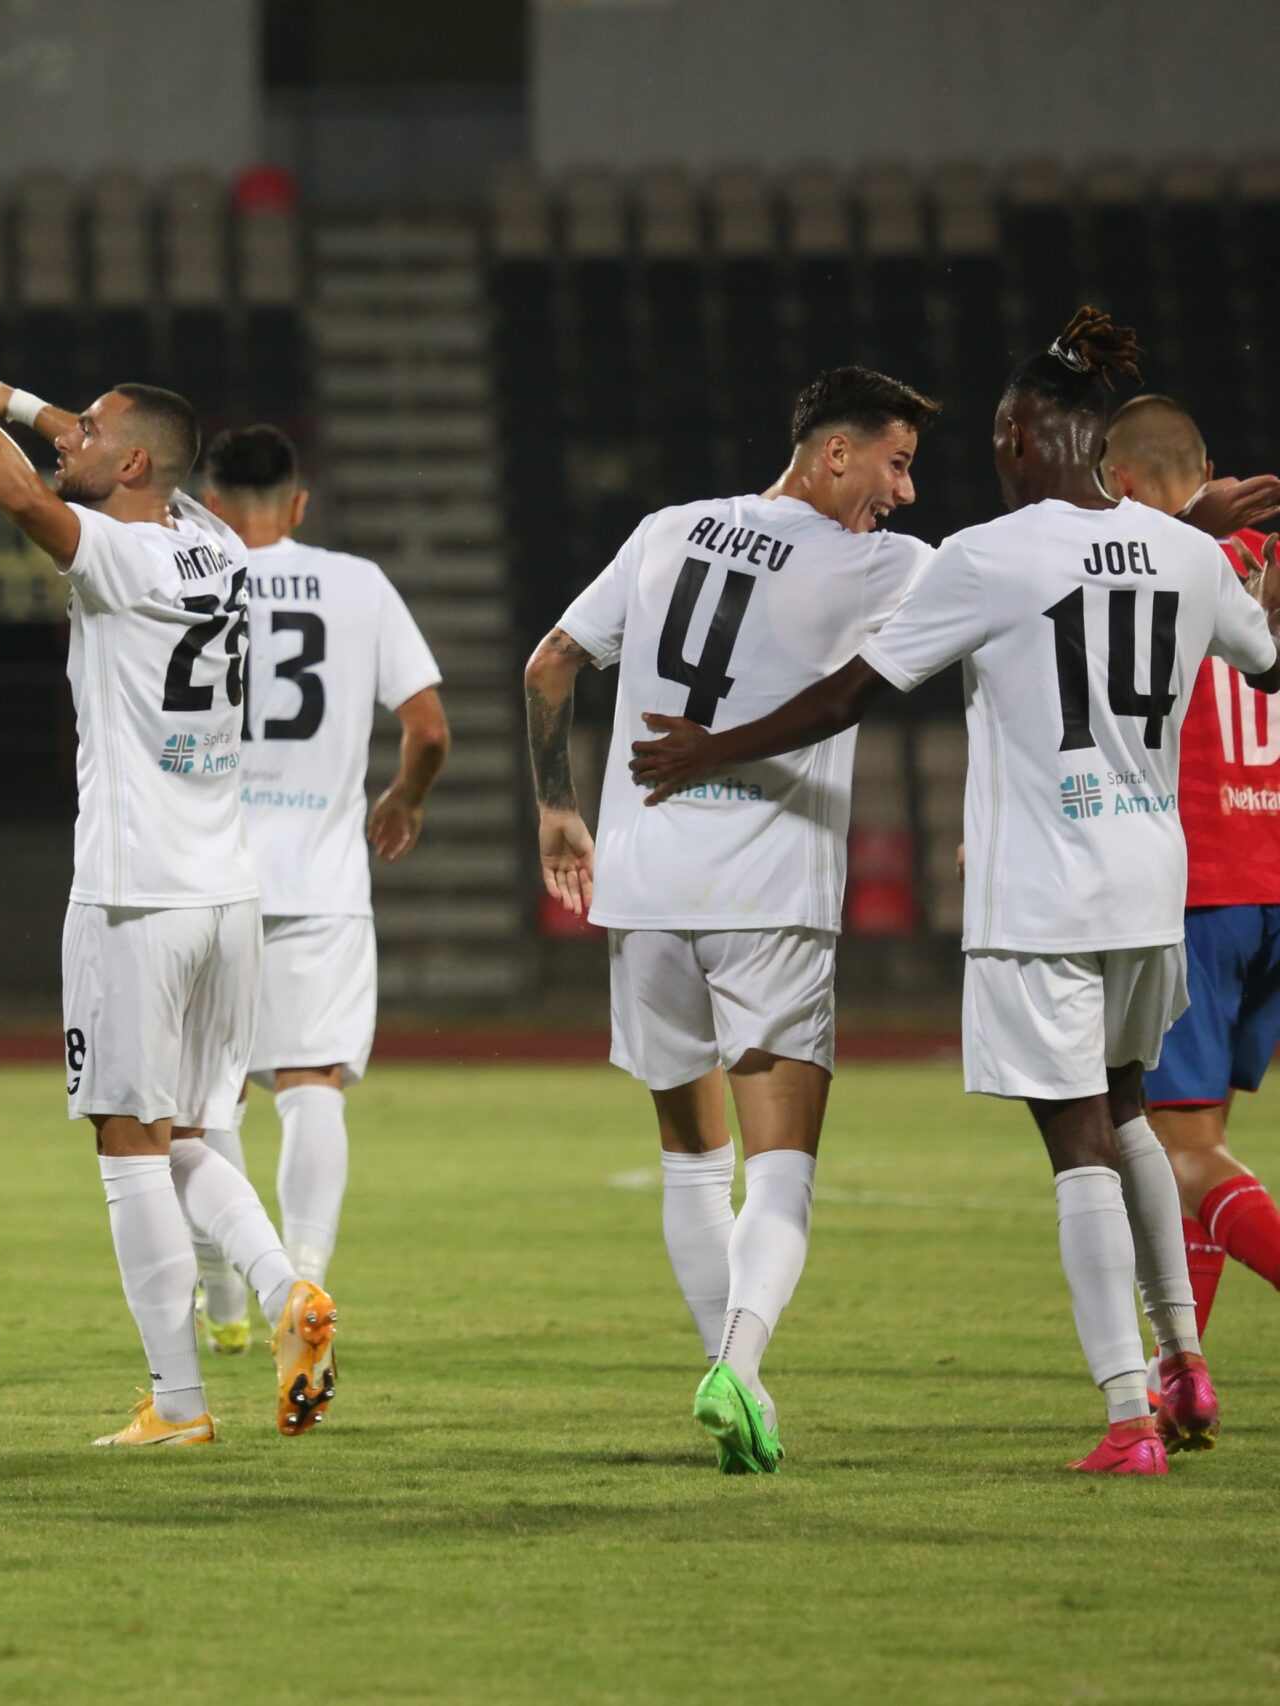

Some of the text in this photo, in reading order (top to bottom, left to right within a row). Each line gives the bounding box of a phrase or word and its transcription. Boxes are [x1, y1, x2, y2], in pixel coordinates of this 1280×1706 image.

[687, 516, 794, 572] ALIYEV
[1083, 541, 1157, 575] JOEL
[657, 556, 757, 728] 4
[1041, 585, 1179, 752] 14
[672, 777, 763, 802] avita
